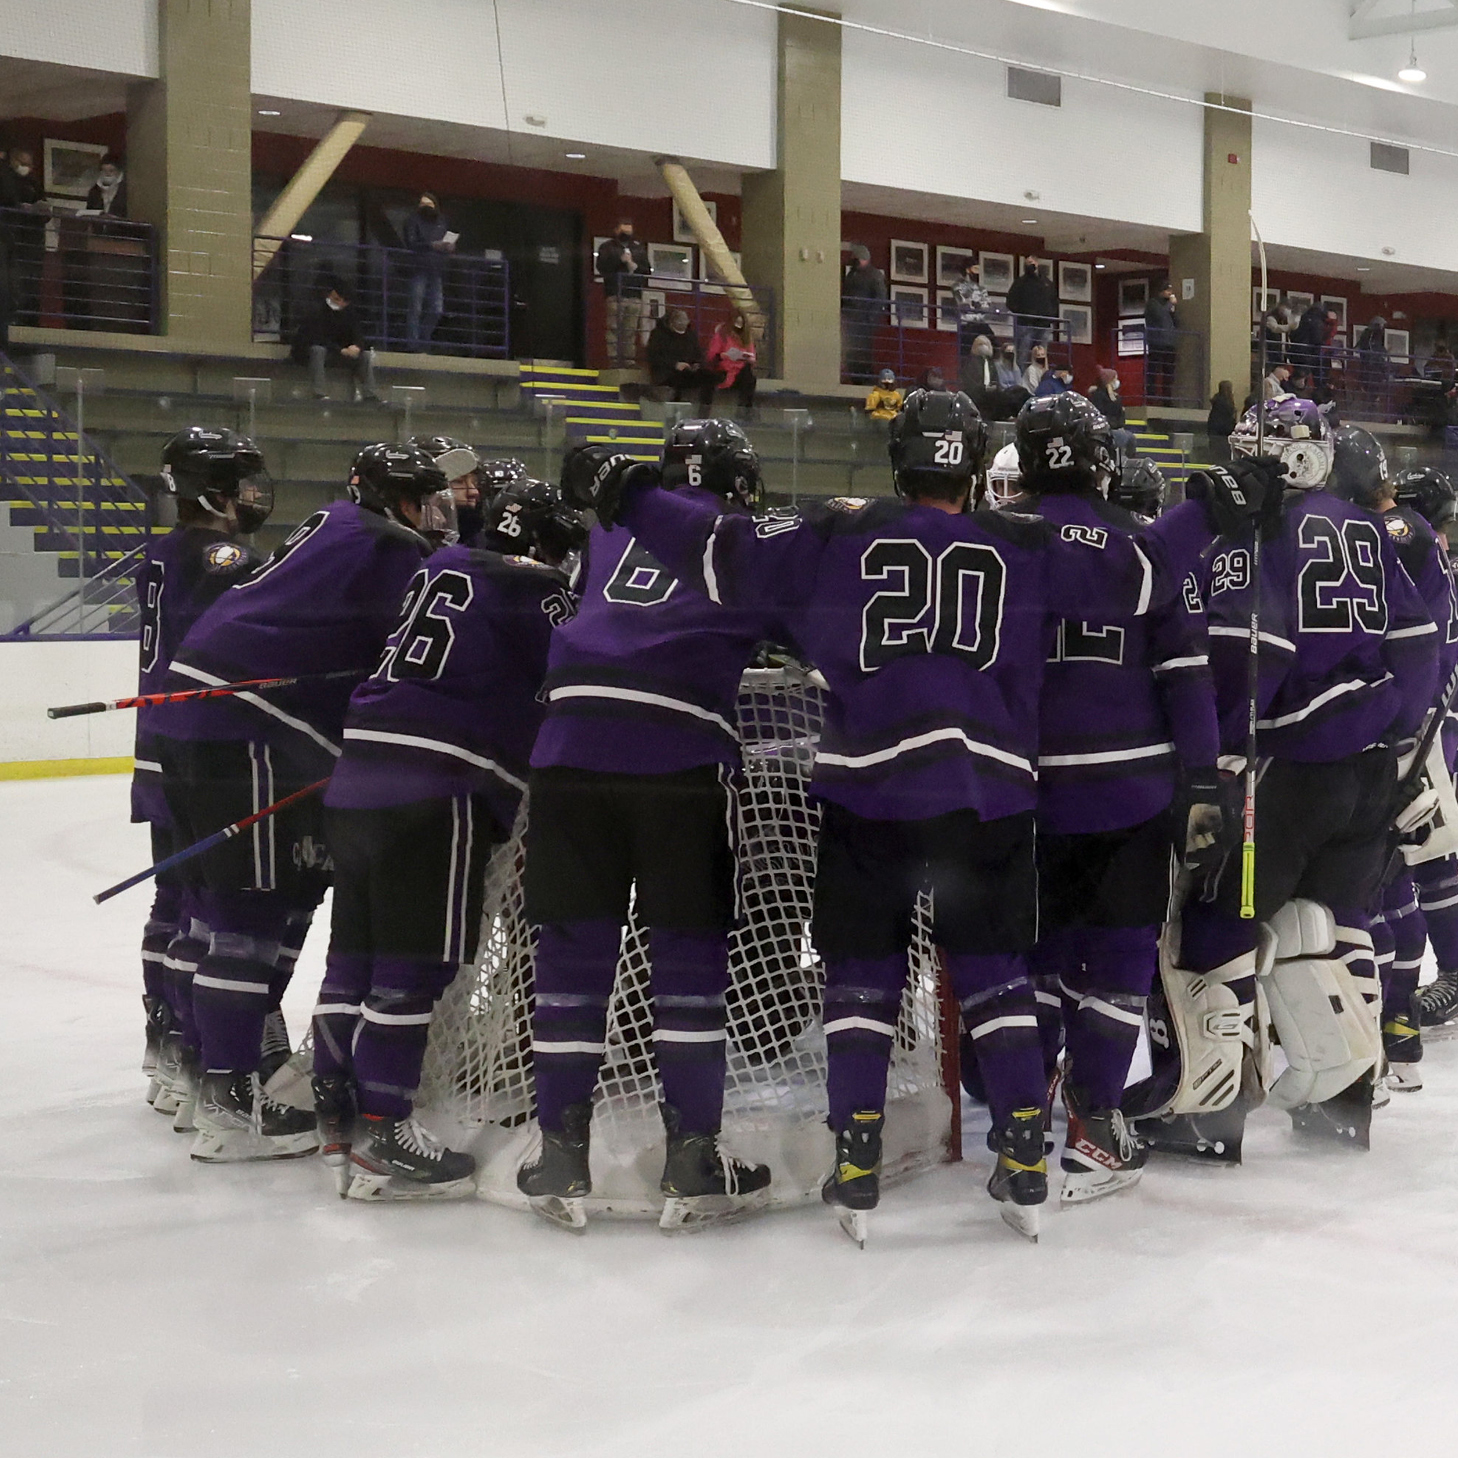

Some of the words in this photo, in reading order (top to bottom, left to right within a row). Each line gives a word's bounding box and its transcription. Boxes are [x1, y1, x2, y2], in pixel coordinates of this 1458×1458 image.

[934, 440, 963, 465] 20
[1046, 445, 1075, 470] 22
[688, 464, 702, 486] 6
[497, 511, 522, 538] 26
[603, 536, 679, 607] 6
[1211, 547, 1251, 597] 29
[1297, 513, 1389, 635] 29
[860, 538, 1007, 673] 20
[368, 568, 475, 683] 26
[1250, 613, 1258, 655] BAUER
[259, 677, 297, 690] BAUER
[1075, 1137, 1123, 1171] CCM
